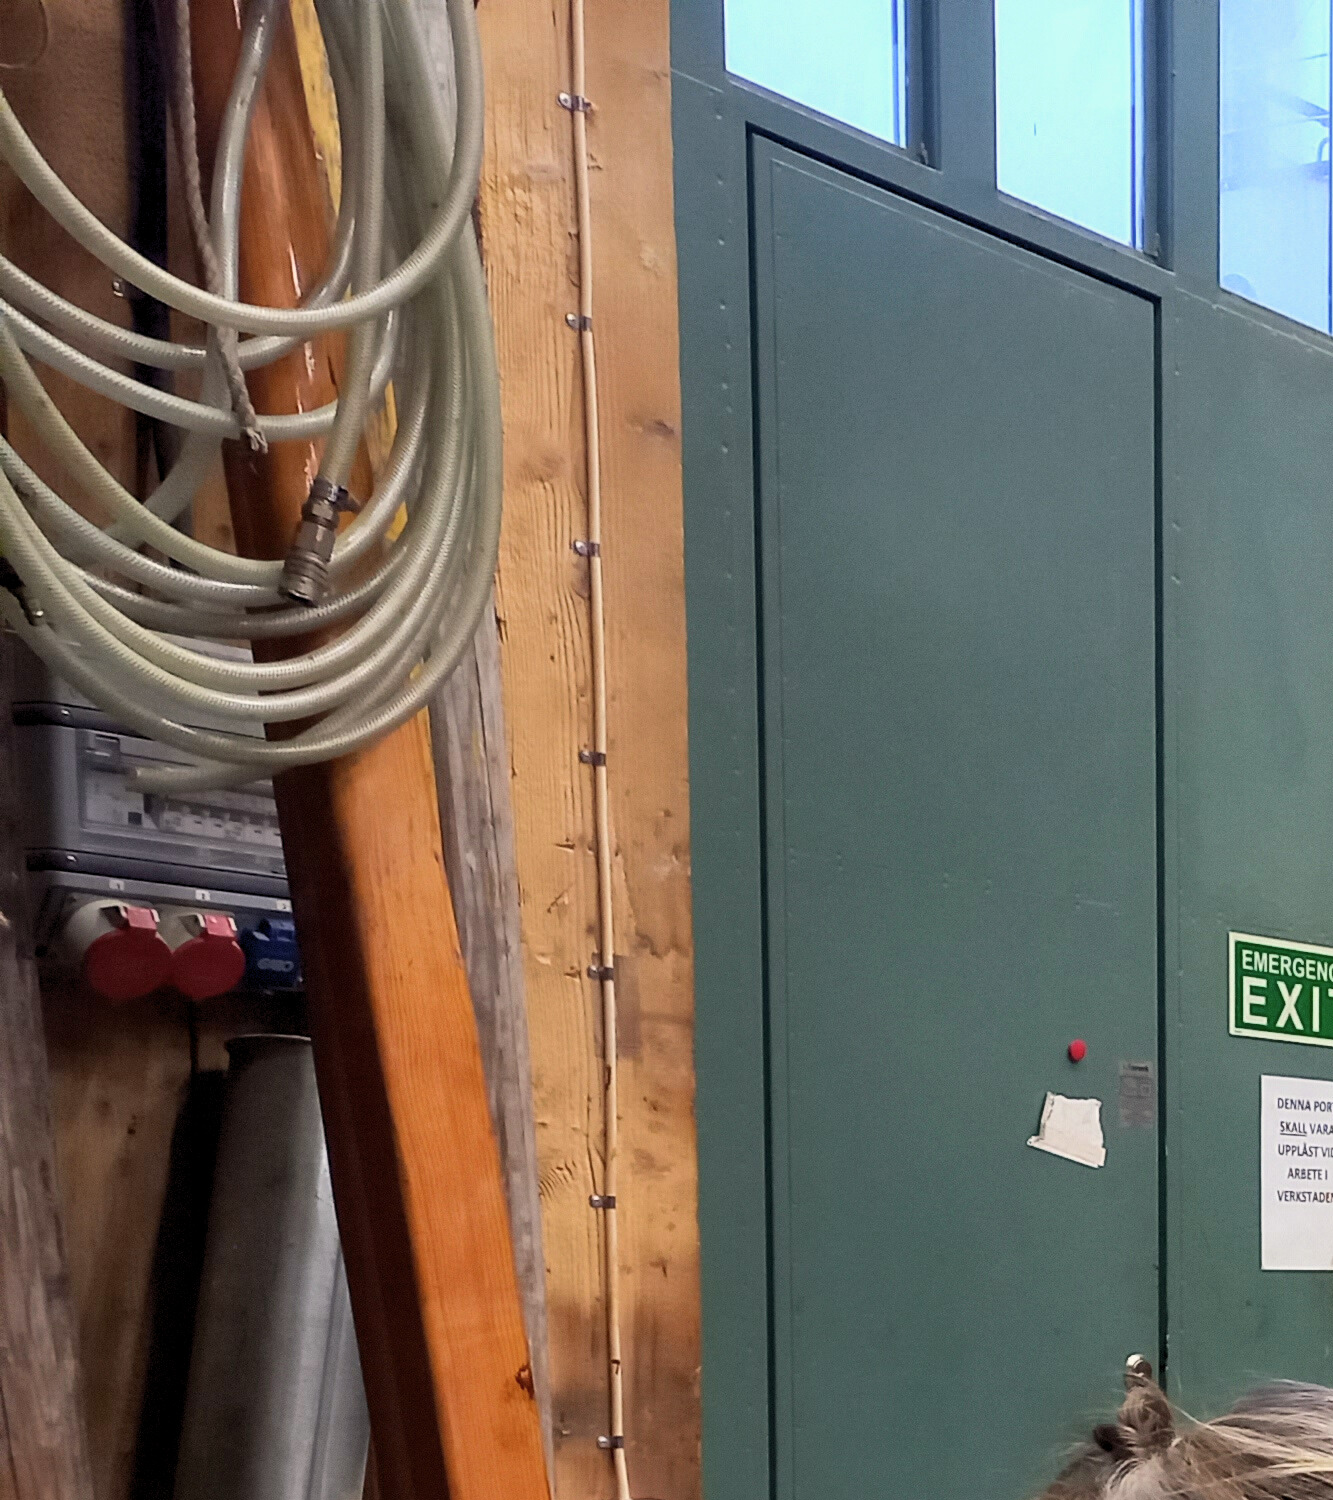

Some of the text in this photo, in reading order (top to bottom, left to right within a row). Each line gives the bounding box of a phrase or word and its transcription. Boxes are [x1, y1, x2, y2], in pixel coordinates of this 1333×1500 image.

[1277, 1097, 1311, 1112] DENNA
[1280, 1121, 1307, 1136] SKALL
[1277, 1142, 1320, 1158] UPPLÅST
[1287, 1168, 1322, 1181] ARBETE
